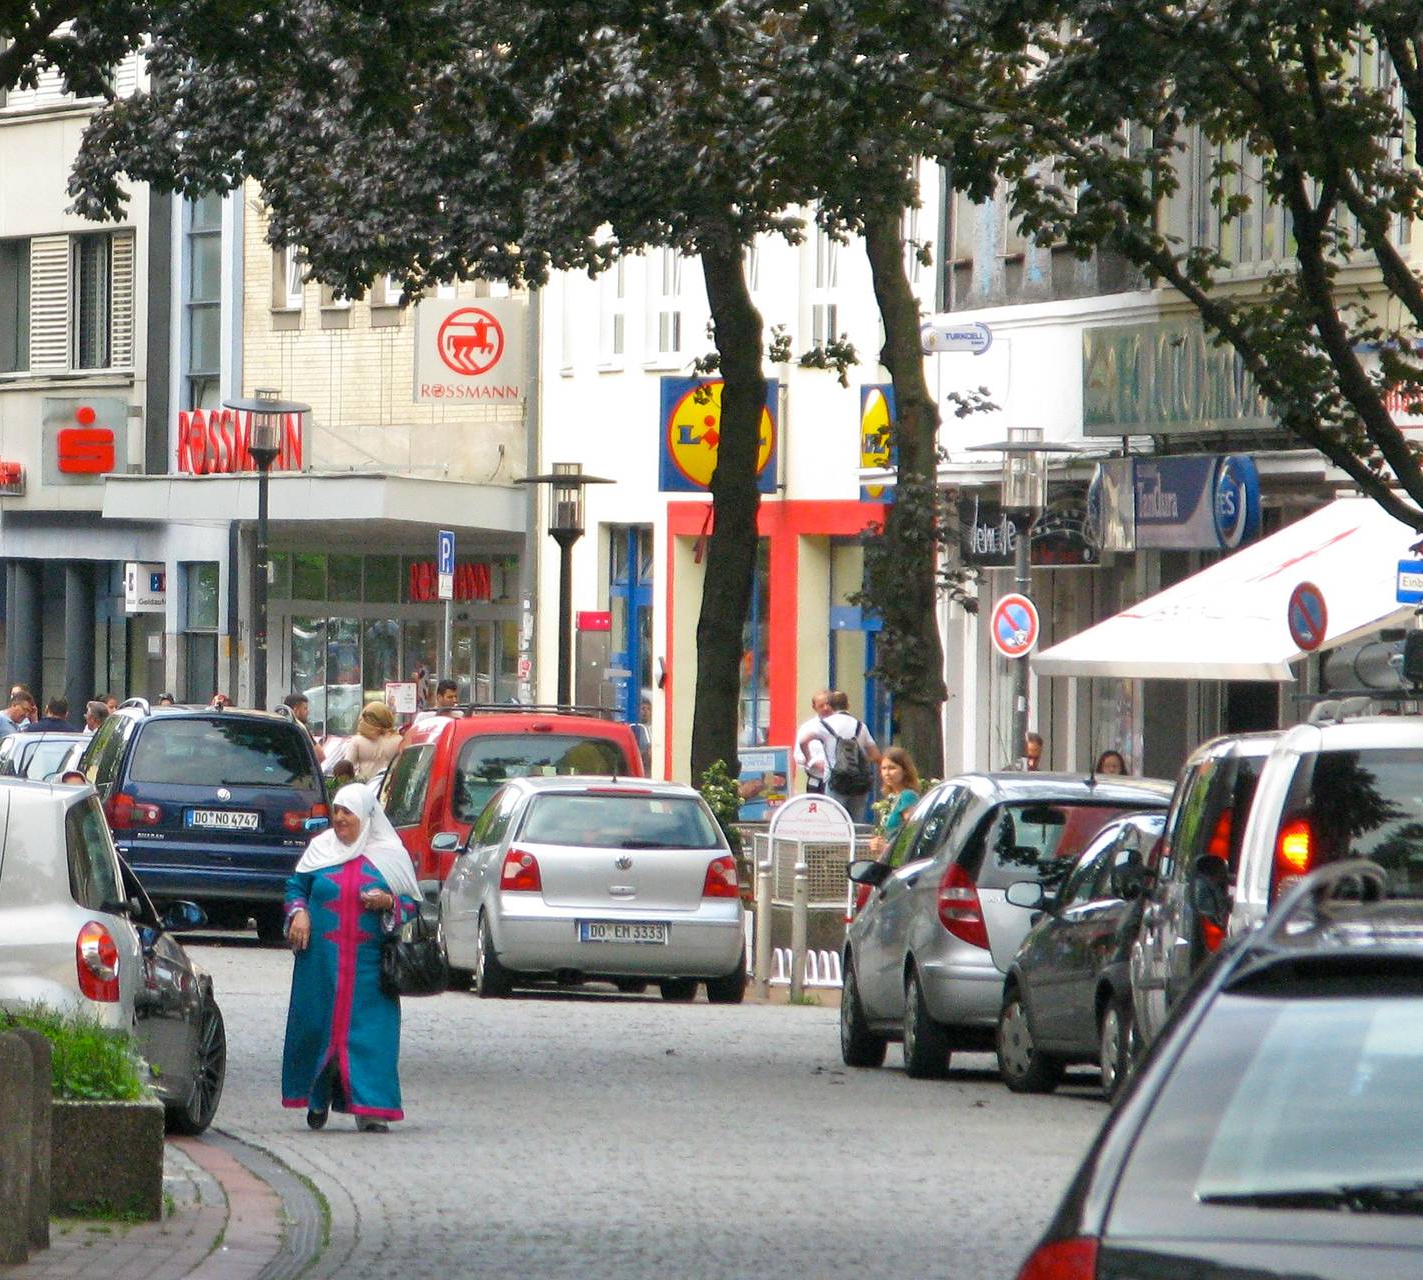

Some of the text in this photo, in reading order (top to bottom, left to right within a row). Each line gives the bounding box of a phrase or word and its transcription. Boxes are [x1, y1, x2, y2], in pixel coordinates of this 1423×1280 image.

[421, 384, 519, 399] ROSSMANN
[194, 812, 208, 824] DO
[231, 814, 257, 826] 4747
[590, 924, 663, 940] DO EM 3333
